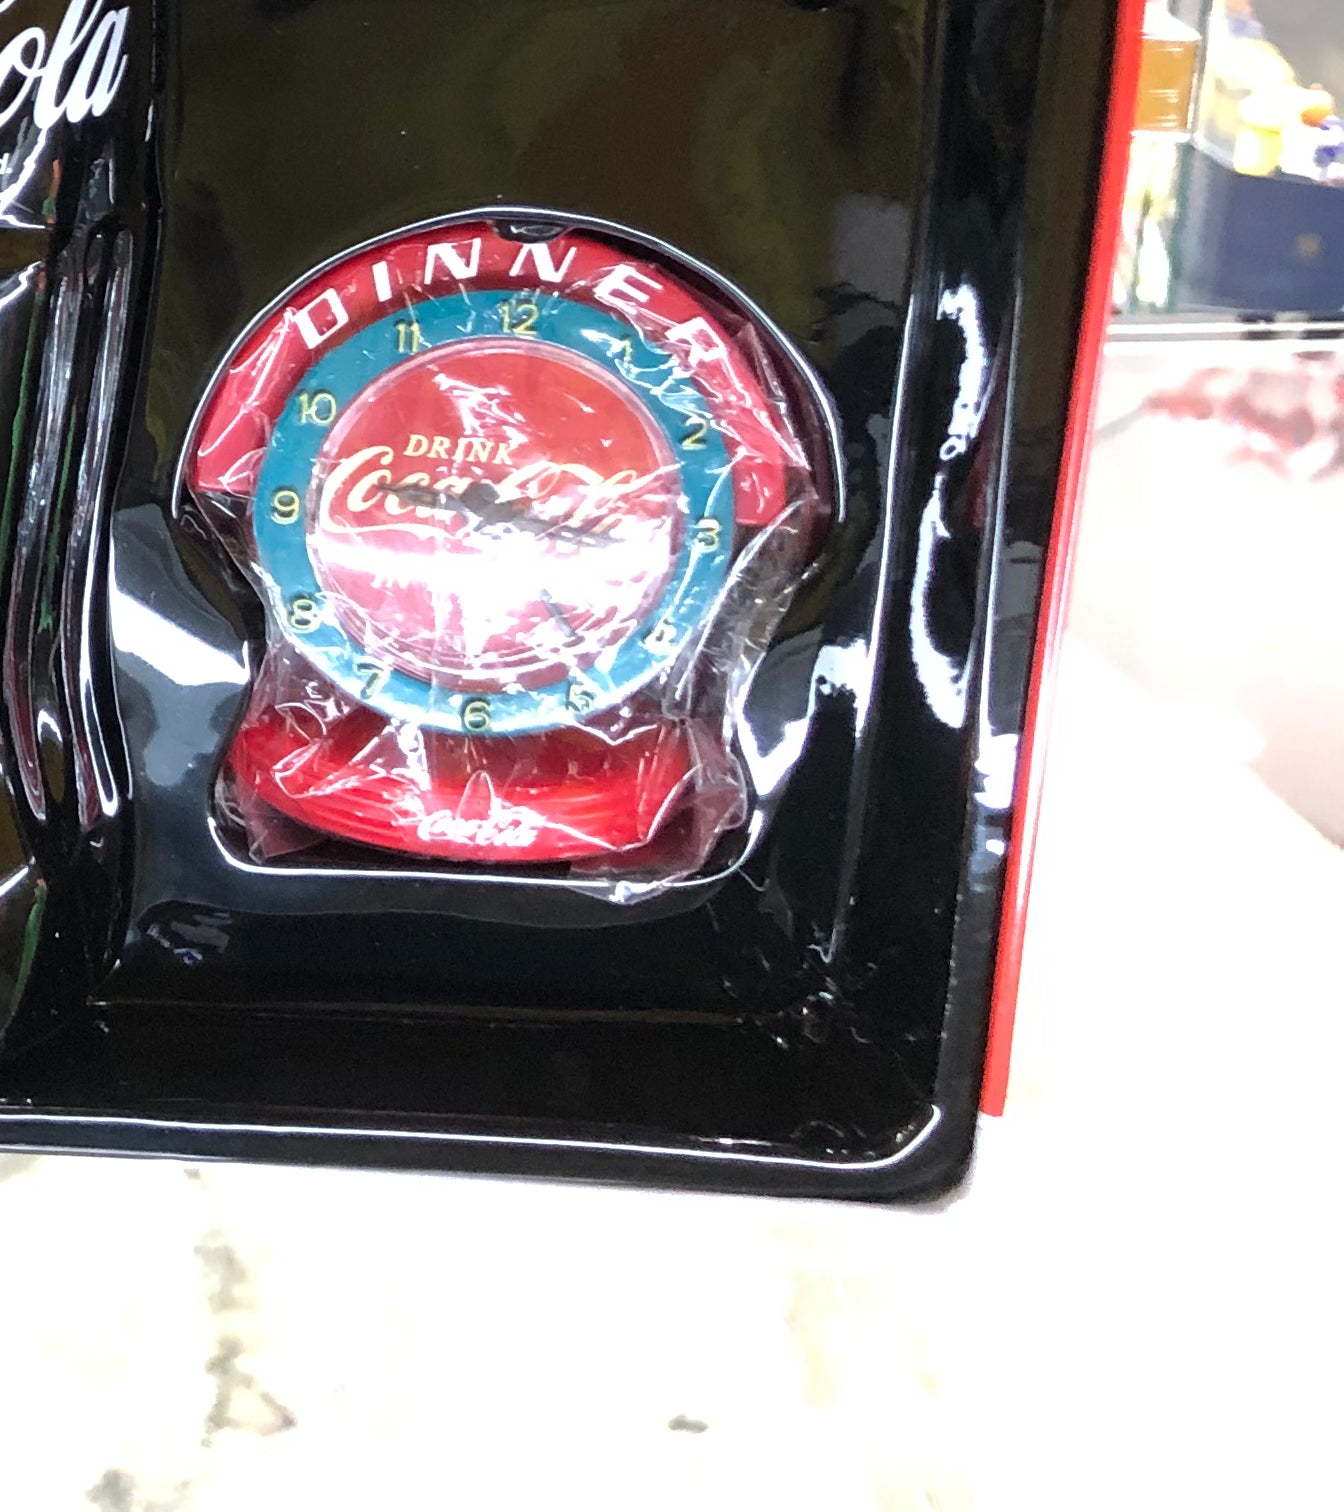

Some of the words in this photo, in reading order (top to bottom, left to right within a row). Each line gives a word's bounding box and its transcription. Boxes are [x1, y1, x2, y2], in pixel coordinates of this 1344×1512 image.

[292, 238, 740, 378] DINNER
[502, 303, 540, 339] 12
[395, 320, 422, 357] 11
[297, 391, 337, 426] 10
[403, 433, 515, 466] DRINK
[681, 419, 712, 453] 2
[270, 488, 301, 524] 9
[694, 518, 721, 554] 3
[289, 598, 320, 634] 8
[461, 700, 493, 733] 6
